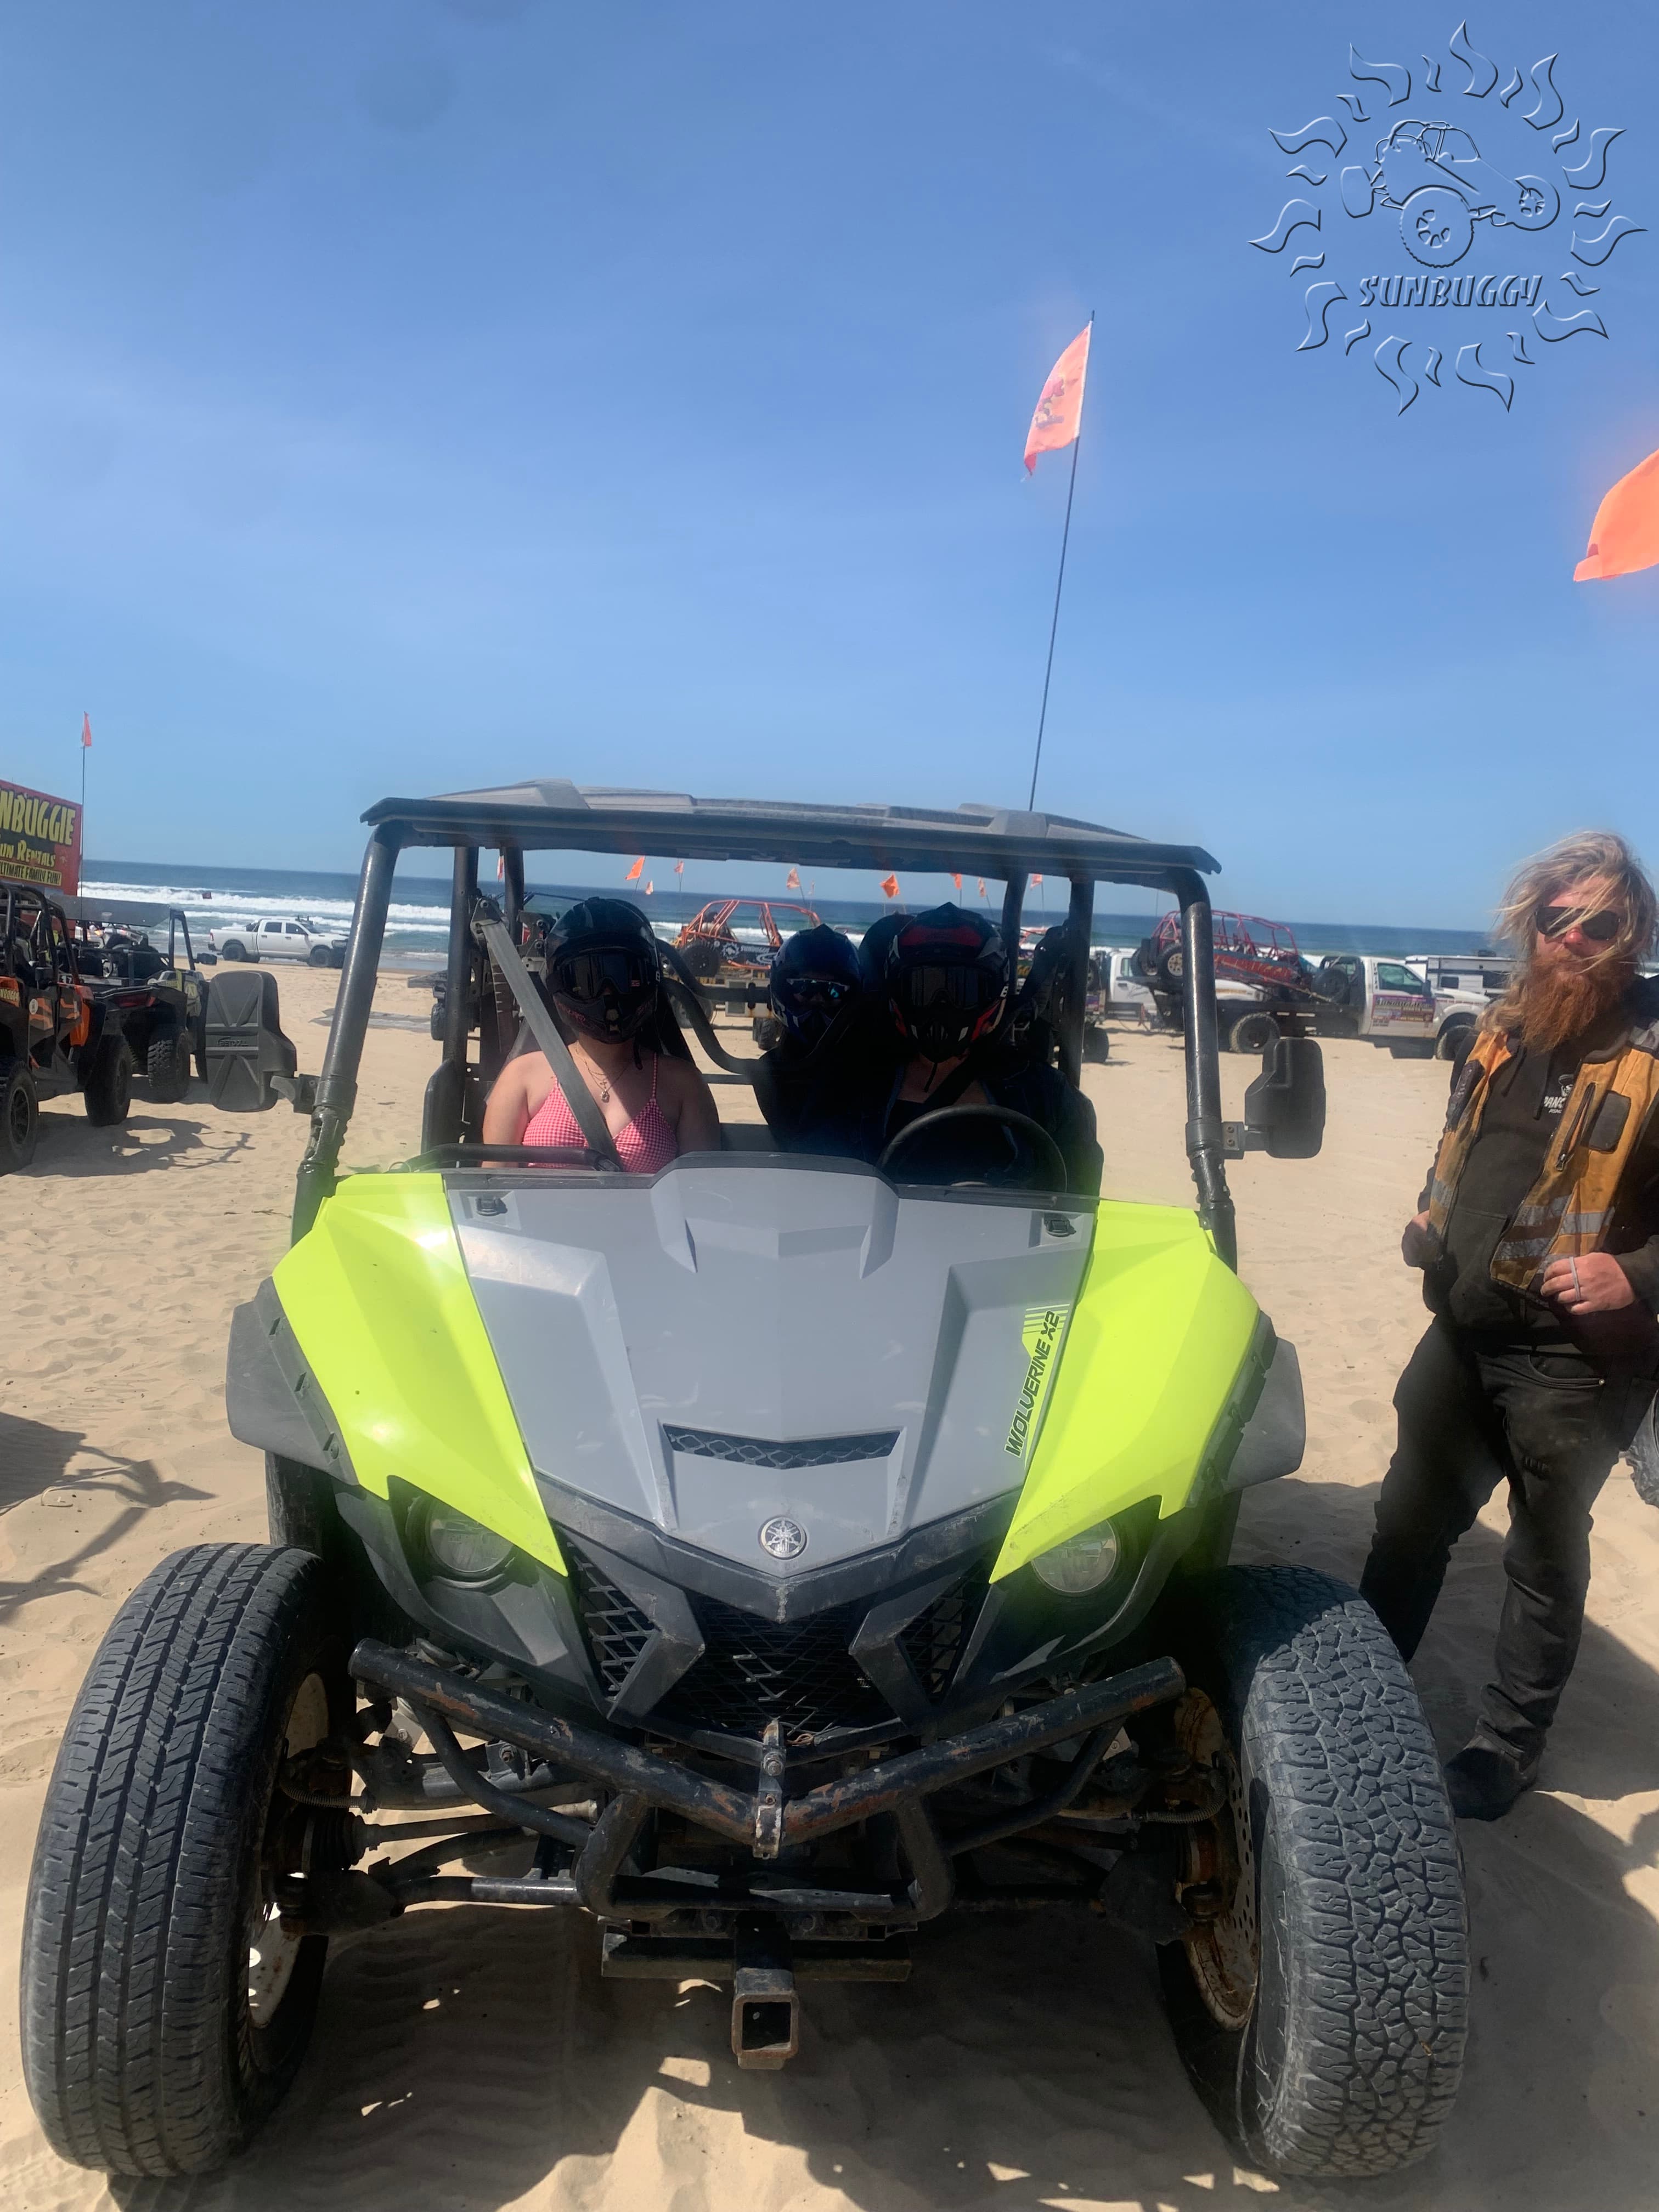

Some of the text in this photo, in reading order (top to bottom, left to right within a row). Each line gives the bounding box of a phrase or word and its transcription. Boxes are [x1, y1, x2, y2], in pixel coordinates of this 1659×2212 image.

[26, 867, 45, 883] FAMILY
[46, 870, 60, 885] FUN!
[1005, 1310, 1060, 1458] WOLVERINE X2
